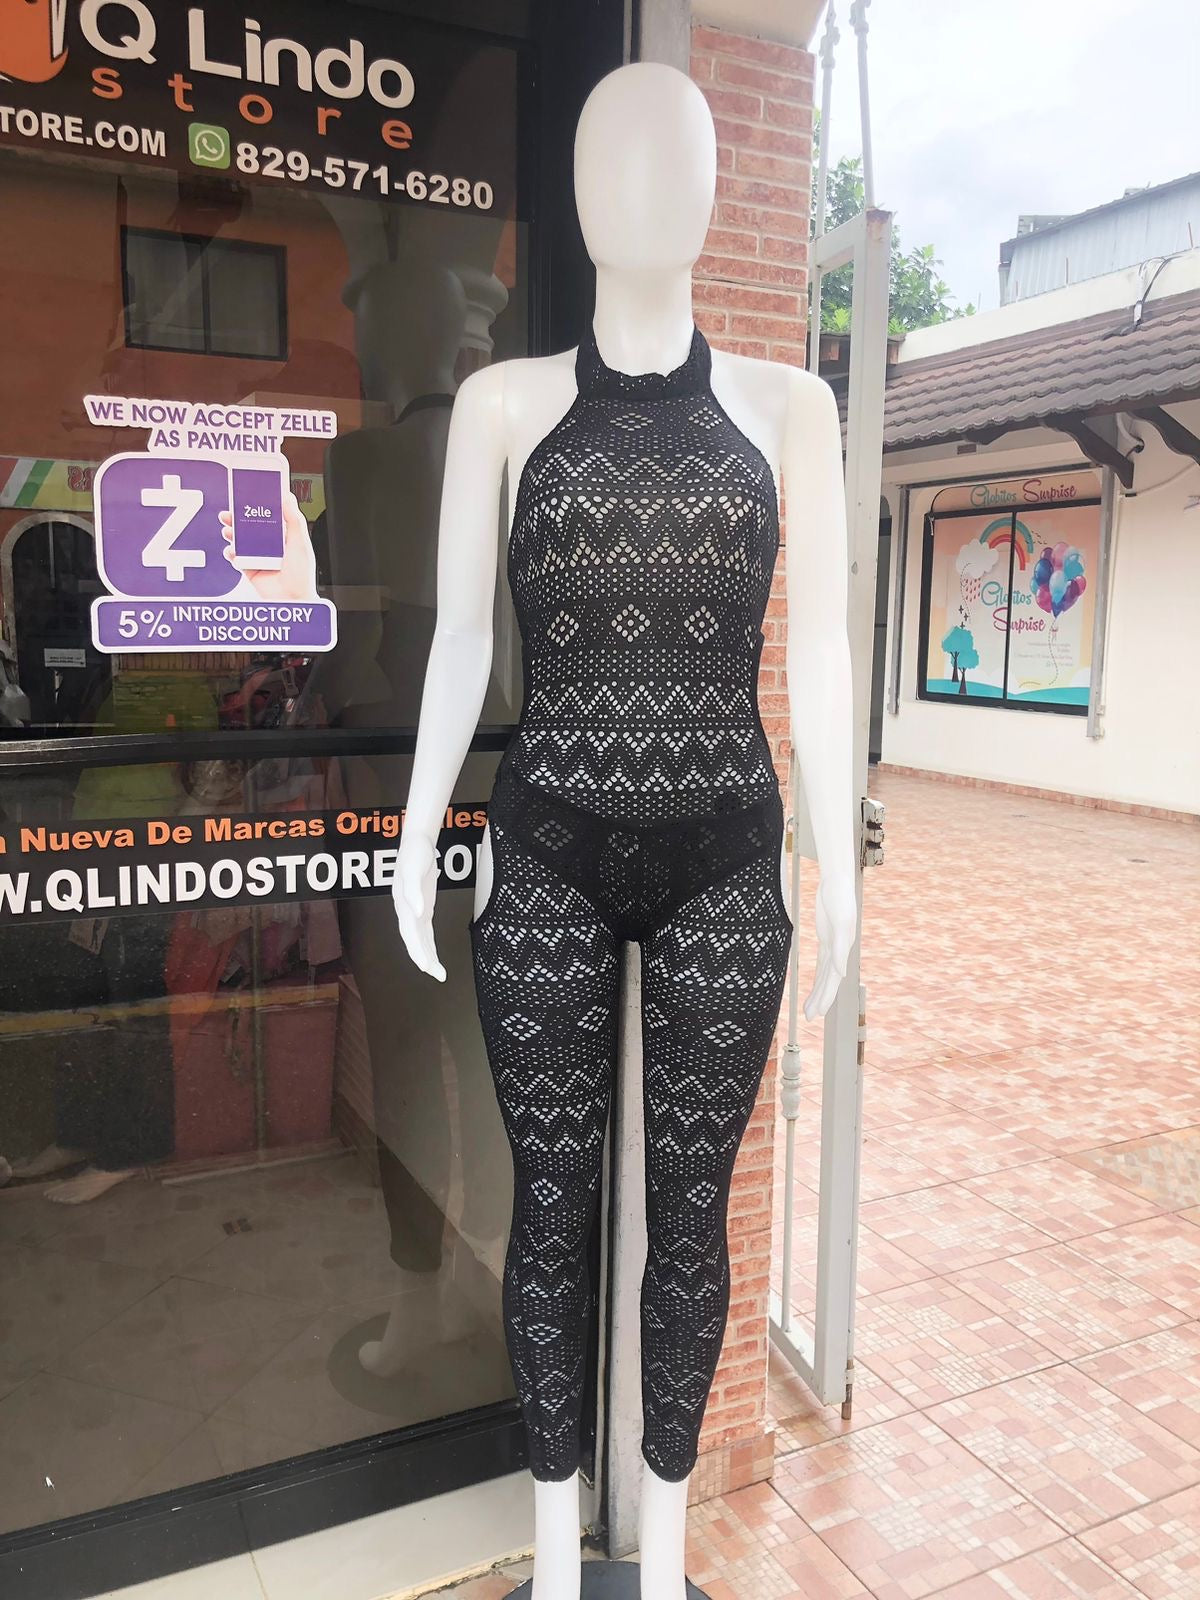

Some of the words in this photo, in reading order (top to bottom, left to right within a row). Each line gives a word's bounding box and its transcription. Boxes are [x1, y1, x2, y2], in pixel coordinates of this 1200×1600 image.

[79, 0, 157, 64] Q
[187, 7, 416, 109] Lindo
[236, 142, 494, 210] 829-571-6280
[90, 401, 124, 420] WE
[132, 404, 187, 424] NOW
[193, 409, 275, 430] ACCEPT
[281, 414, 332, 433] ZELLE
[154, 429, 181, 449] AS
[187, 431, 278, 453] PAYMENT
[1023, 479, 1076, 503] Surprise
[244, 505, 272, 518] Zelle
[118, 610, 172, 638] 5%
[173, 606, 313, 623] INTRODUCTORY
[198, 626, 291, 641] DISCOUNT
[20, 827, 135, 853] Nueva
[147, 820, 192, 846] De
[204, 815, 325, 842] Marcas
